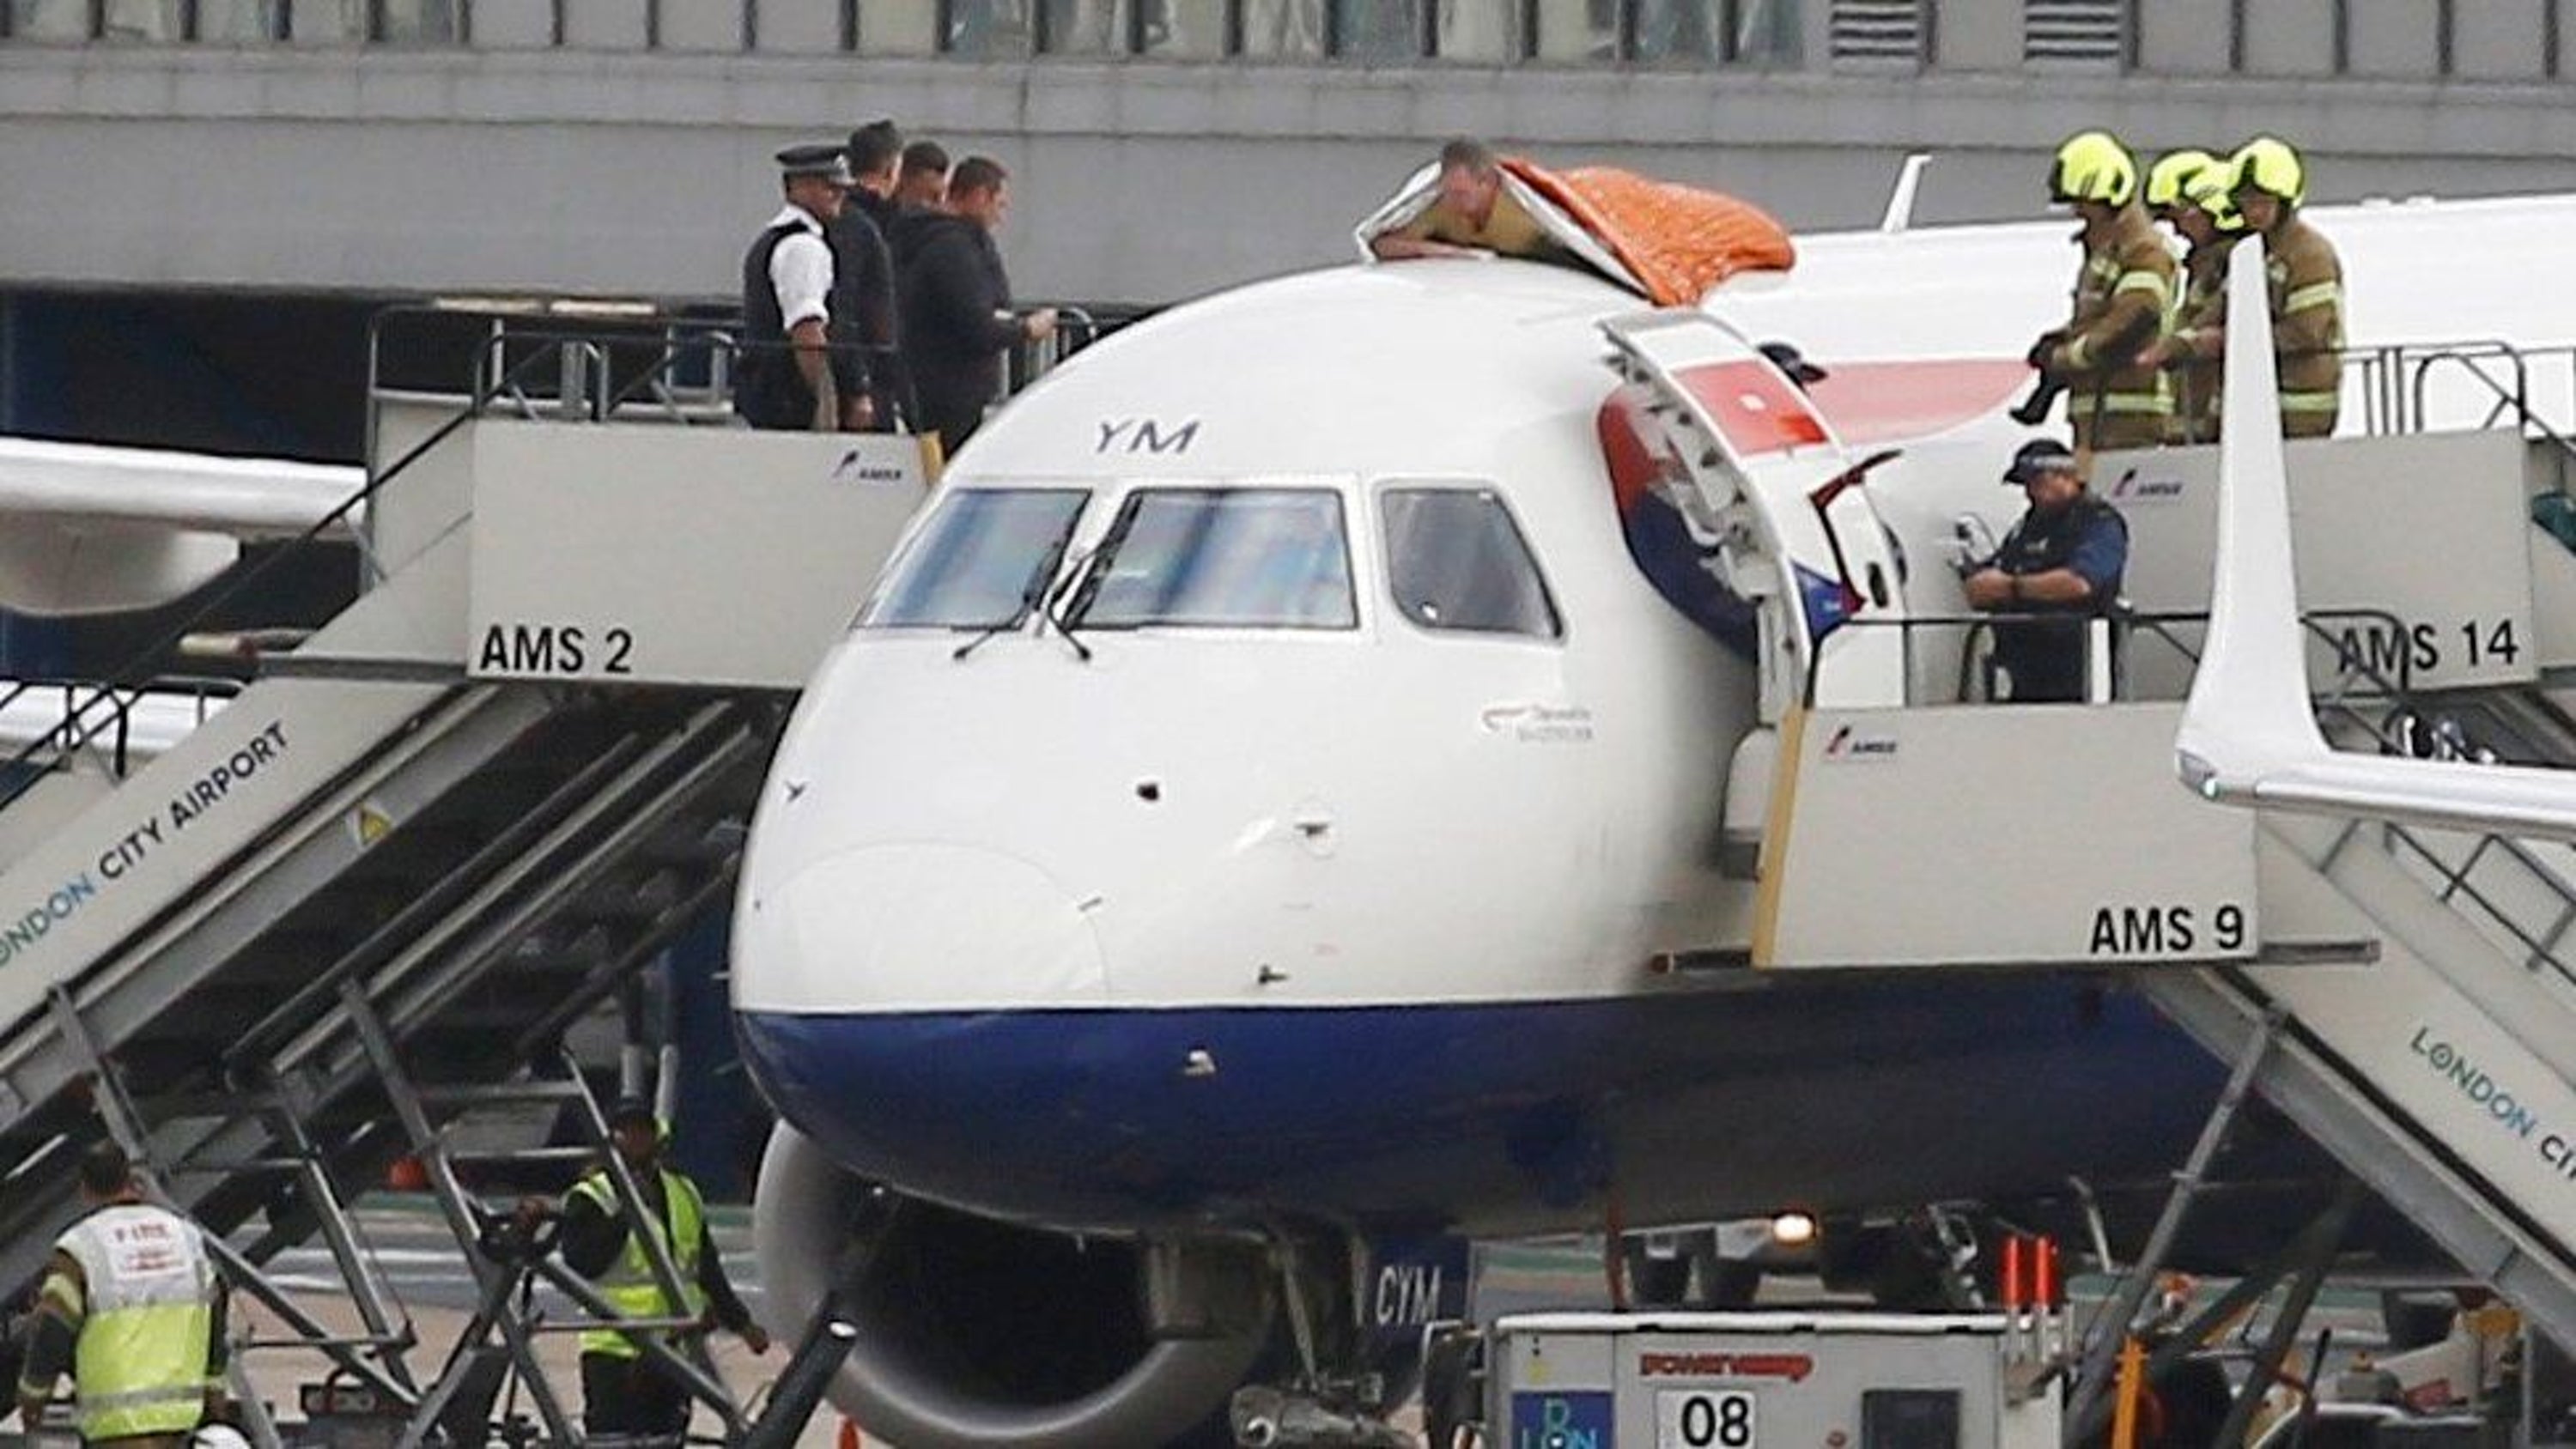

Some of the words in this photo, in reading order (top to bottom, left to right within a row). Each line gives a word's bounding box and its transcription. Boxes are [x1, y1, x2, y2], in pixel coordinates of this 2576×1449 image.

[1097, 419, 1200, 452] YM
[479, 624, 585, 672] AMS
[605, 628, 632, 673] 2
[2338, 623, 2438, 673] AMS
[2462, 618, 2518, 666] 14
[100, 817, 163, 879] CITY
[170, 721, 286, 828] AIRPORT
[2091, 906, 2193, 953] AMS
[2215, 905, 2243, 949] 9
[2411, 1027, 2538, 1137] LONDON
[1376, 1265, 1441, 1326] CYM
[1682, 1396, 1749, 1447] 08
